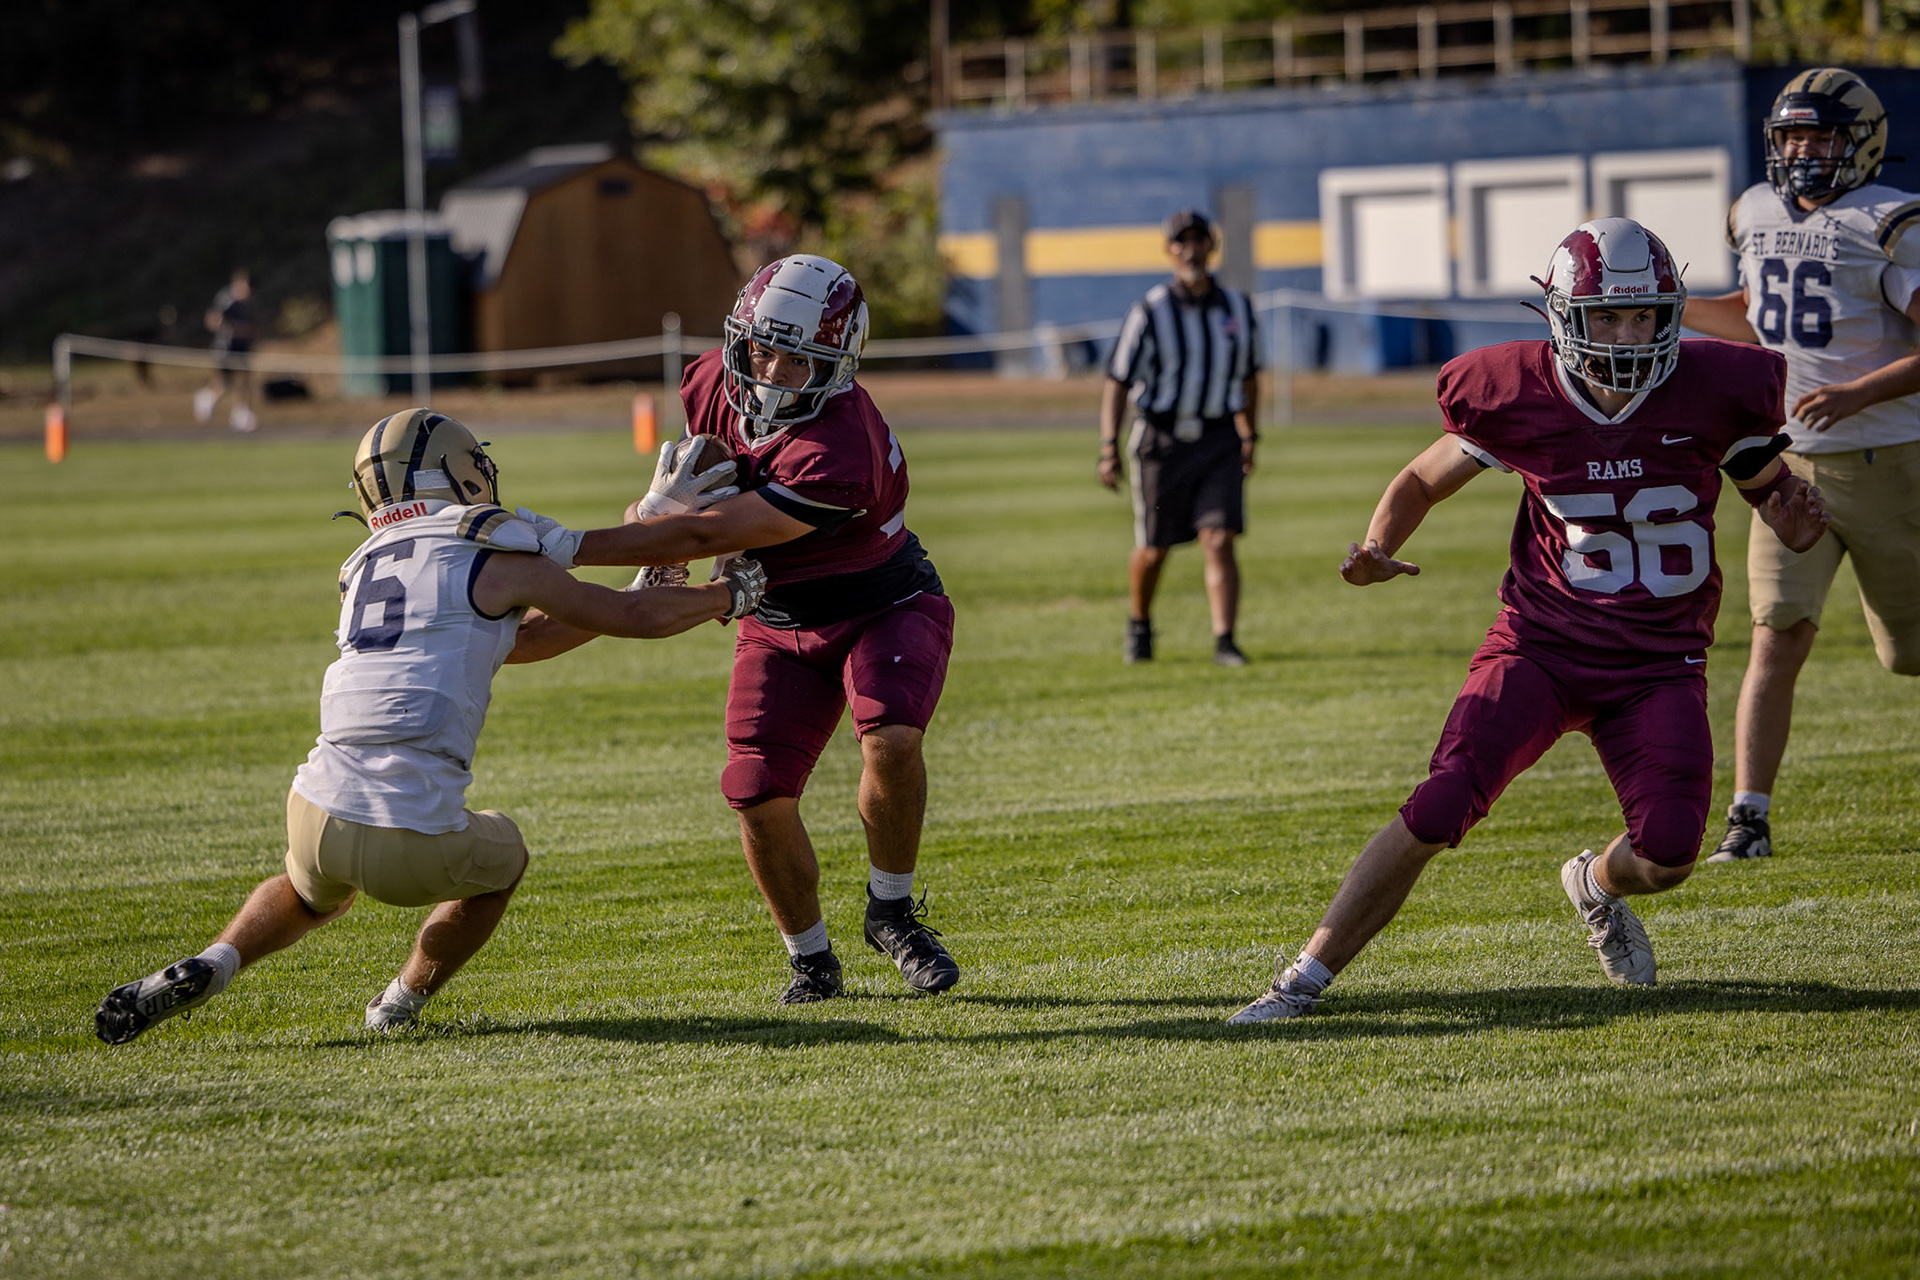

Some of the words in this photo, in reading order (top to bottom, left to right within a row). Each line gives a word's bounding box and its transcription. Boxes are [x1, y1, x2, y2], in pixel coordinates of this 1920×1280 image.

[1753, 232, 1769, 255] ST.
[1775, 232, 1840, 260] BERNARD'S
[1613, 285, 1650, 294] Riddell
[1757, 258, 1833, 349] 66
[1586, 458, 1644, 480] RAMS
[370, 501, 428, 530] Riddell
[1541, 484, 1711, 598] 56
[347, 537, 416, 655] 6
